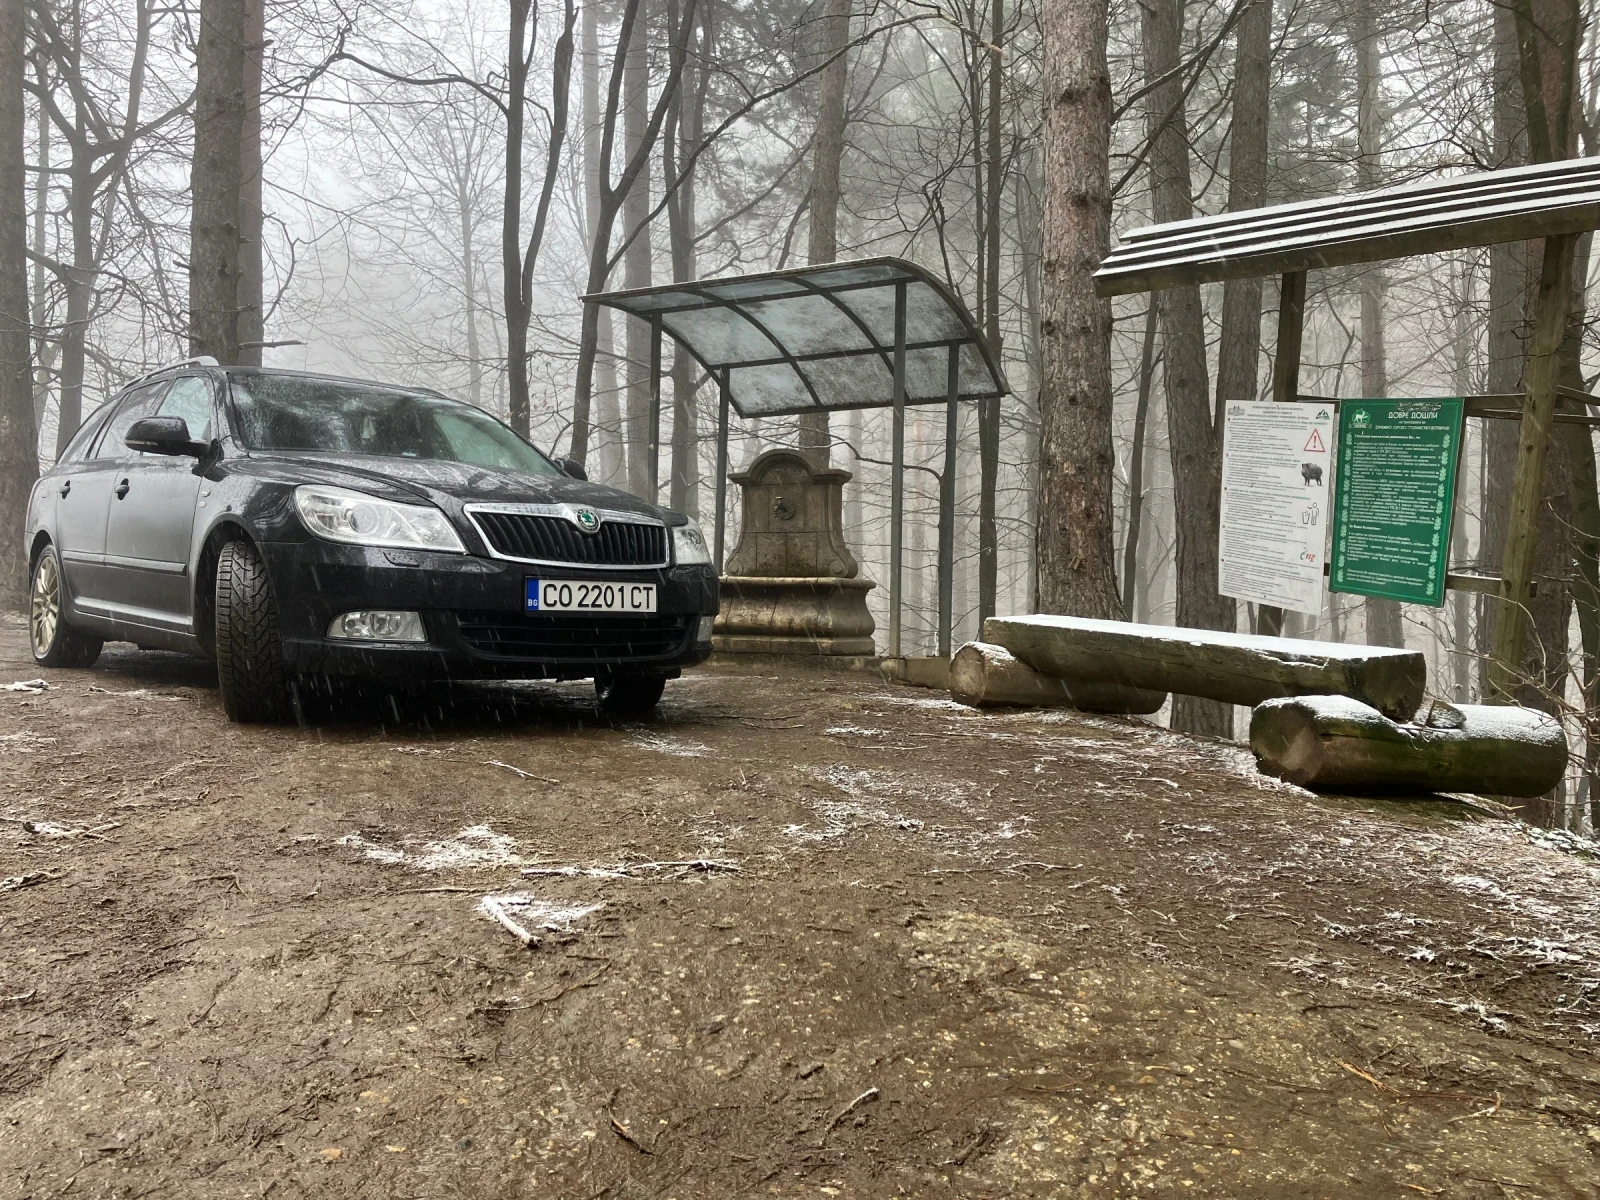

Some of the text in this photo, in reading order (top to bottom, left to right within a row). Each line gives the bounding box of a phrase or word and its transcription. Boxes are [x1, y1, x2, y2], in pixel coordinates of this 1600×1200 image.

[1388, 411, 1438, 419] ДОБРЕ ДОШЛИ
[1306, 553, 1316, 561] 112
[577, 585, 625, 609] 2201
[527, 598, 538, 607] BG
